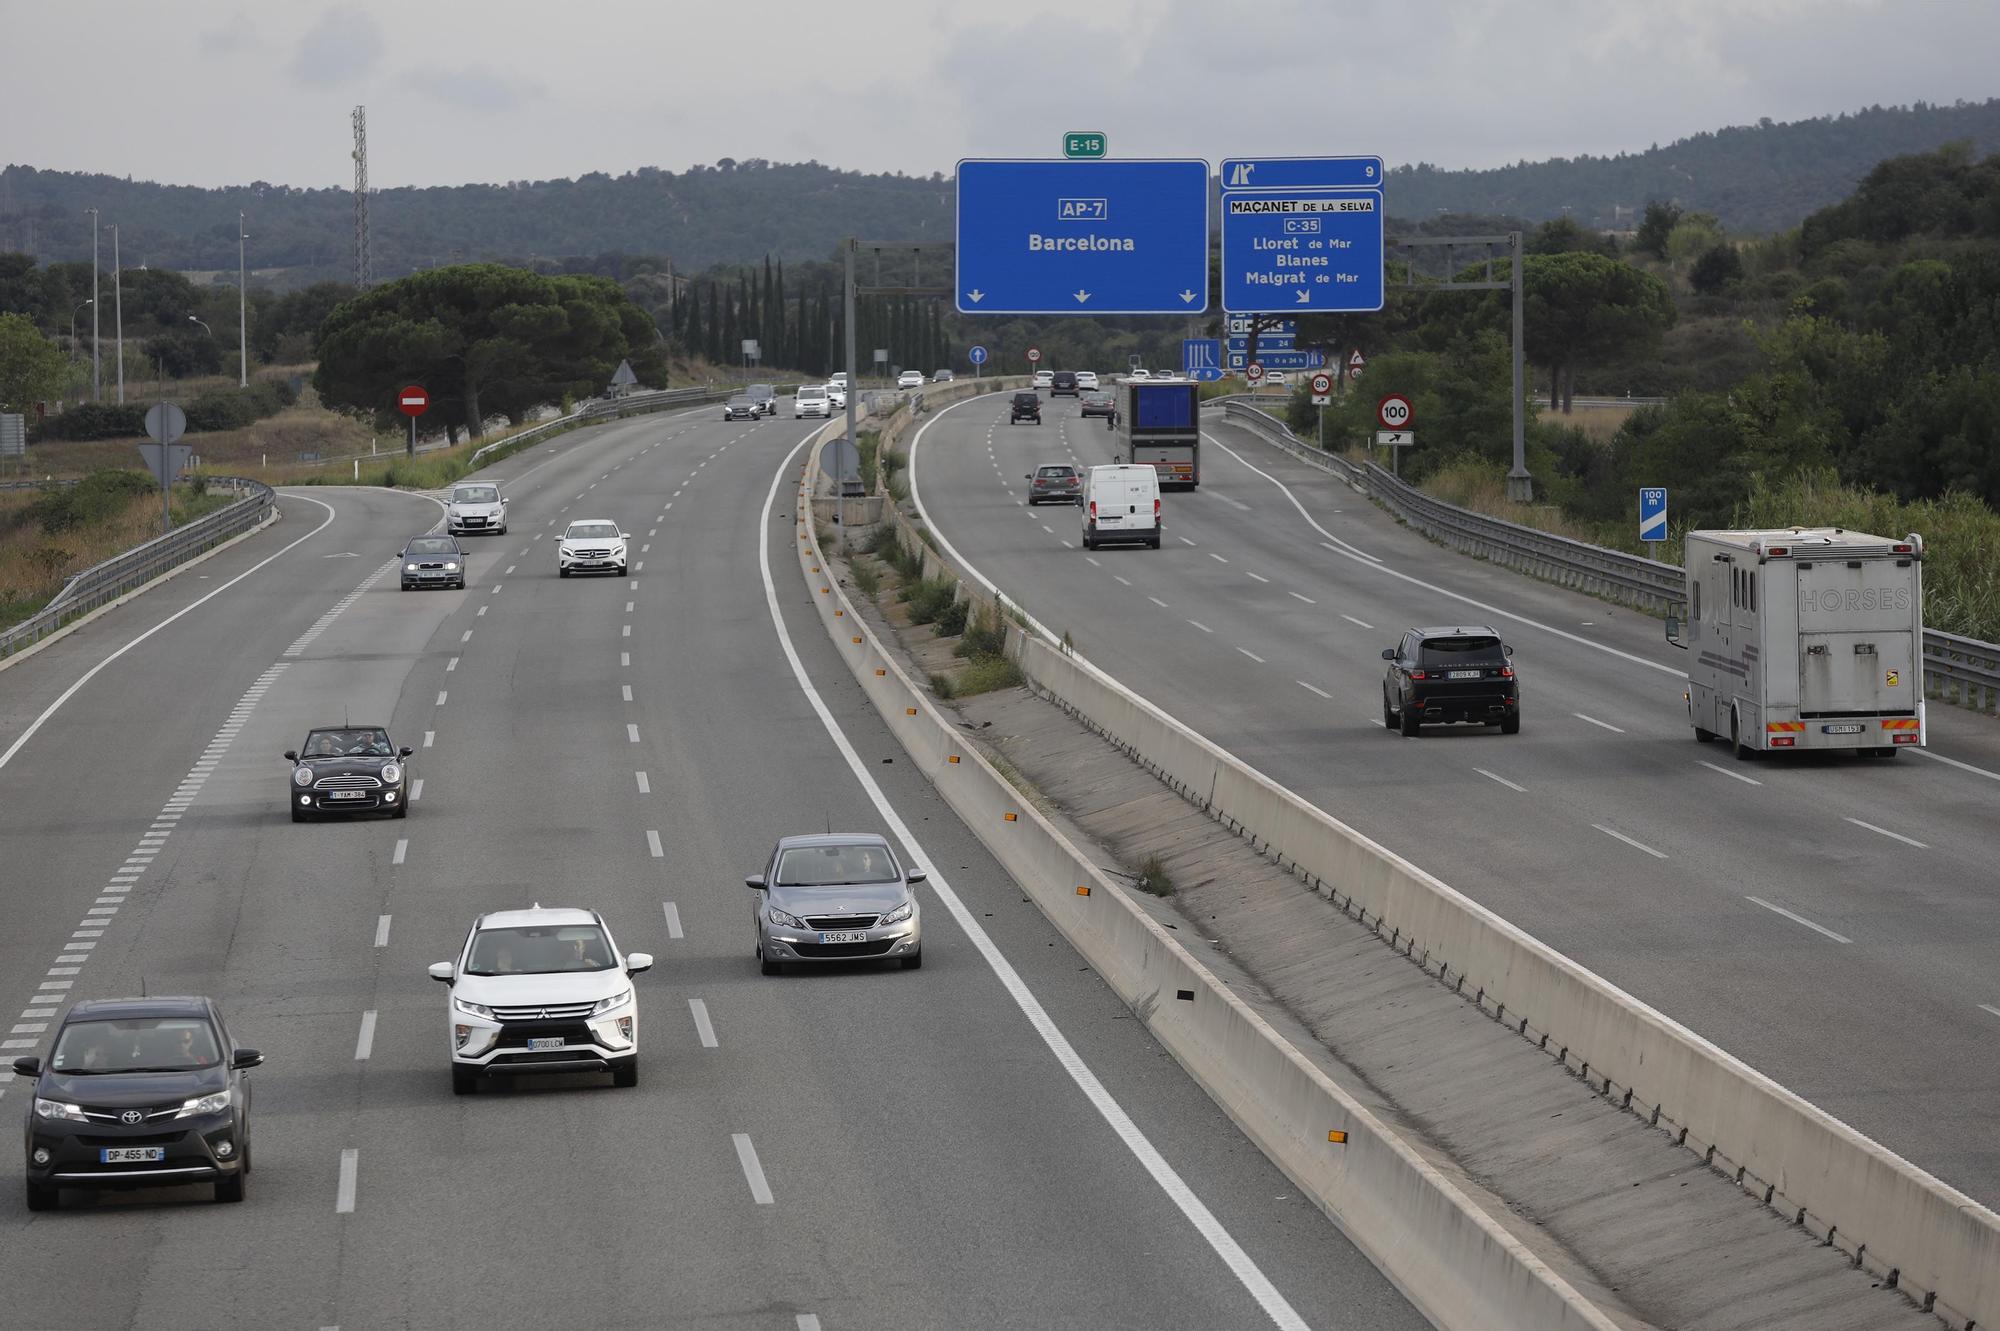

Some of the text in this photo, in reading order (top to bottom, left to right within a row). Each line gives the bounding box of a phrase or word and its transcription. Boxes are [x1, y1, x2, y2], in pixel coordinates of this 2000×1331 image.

[1069, 139, 1100, 152] E-15
[1364, 166, 1375, 178] 9
[1062, 202, 1104, 217] AP-7
[1231, 201, 1373, 214] MAÇANET DE LA SELVA
[1286, 220, 1319, 232] C-35
[1028, 234, 1135, 252] Barcelona
[1253, 237, 1352, 250] Lloret de Mar
[1276, 254, 1329, 267] Blanes
[1246, 271, 1359, 286] Malgrat de Mar
[1206, 370, 1212, 378] 9
[1315, 380, 1328, 388] 80
[1384, 406, 1407, 418] 100
[1645, 491, 1662, 499] 100
[1800, 587, 1910, 612] HORSES
[825, 932, 865, 943] 5562 JMS
[108, 1148, 157, 1162] DP-455-ND
